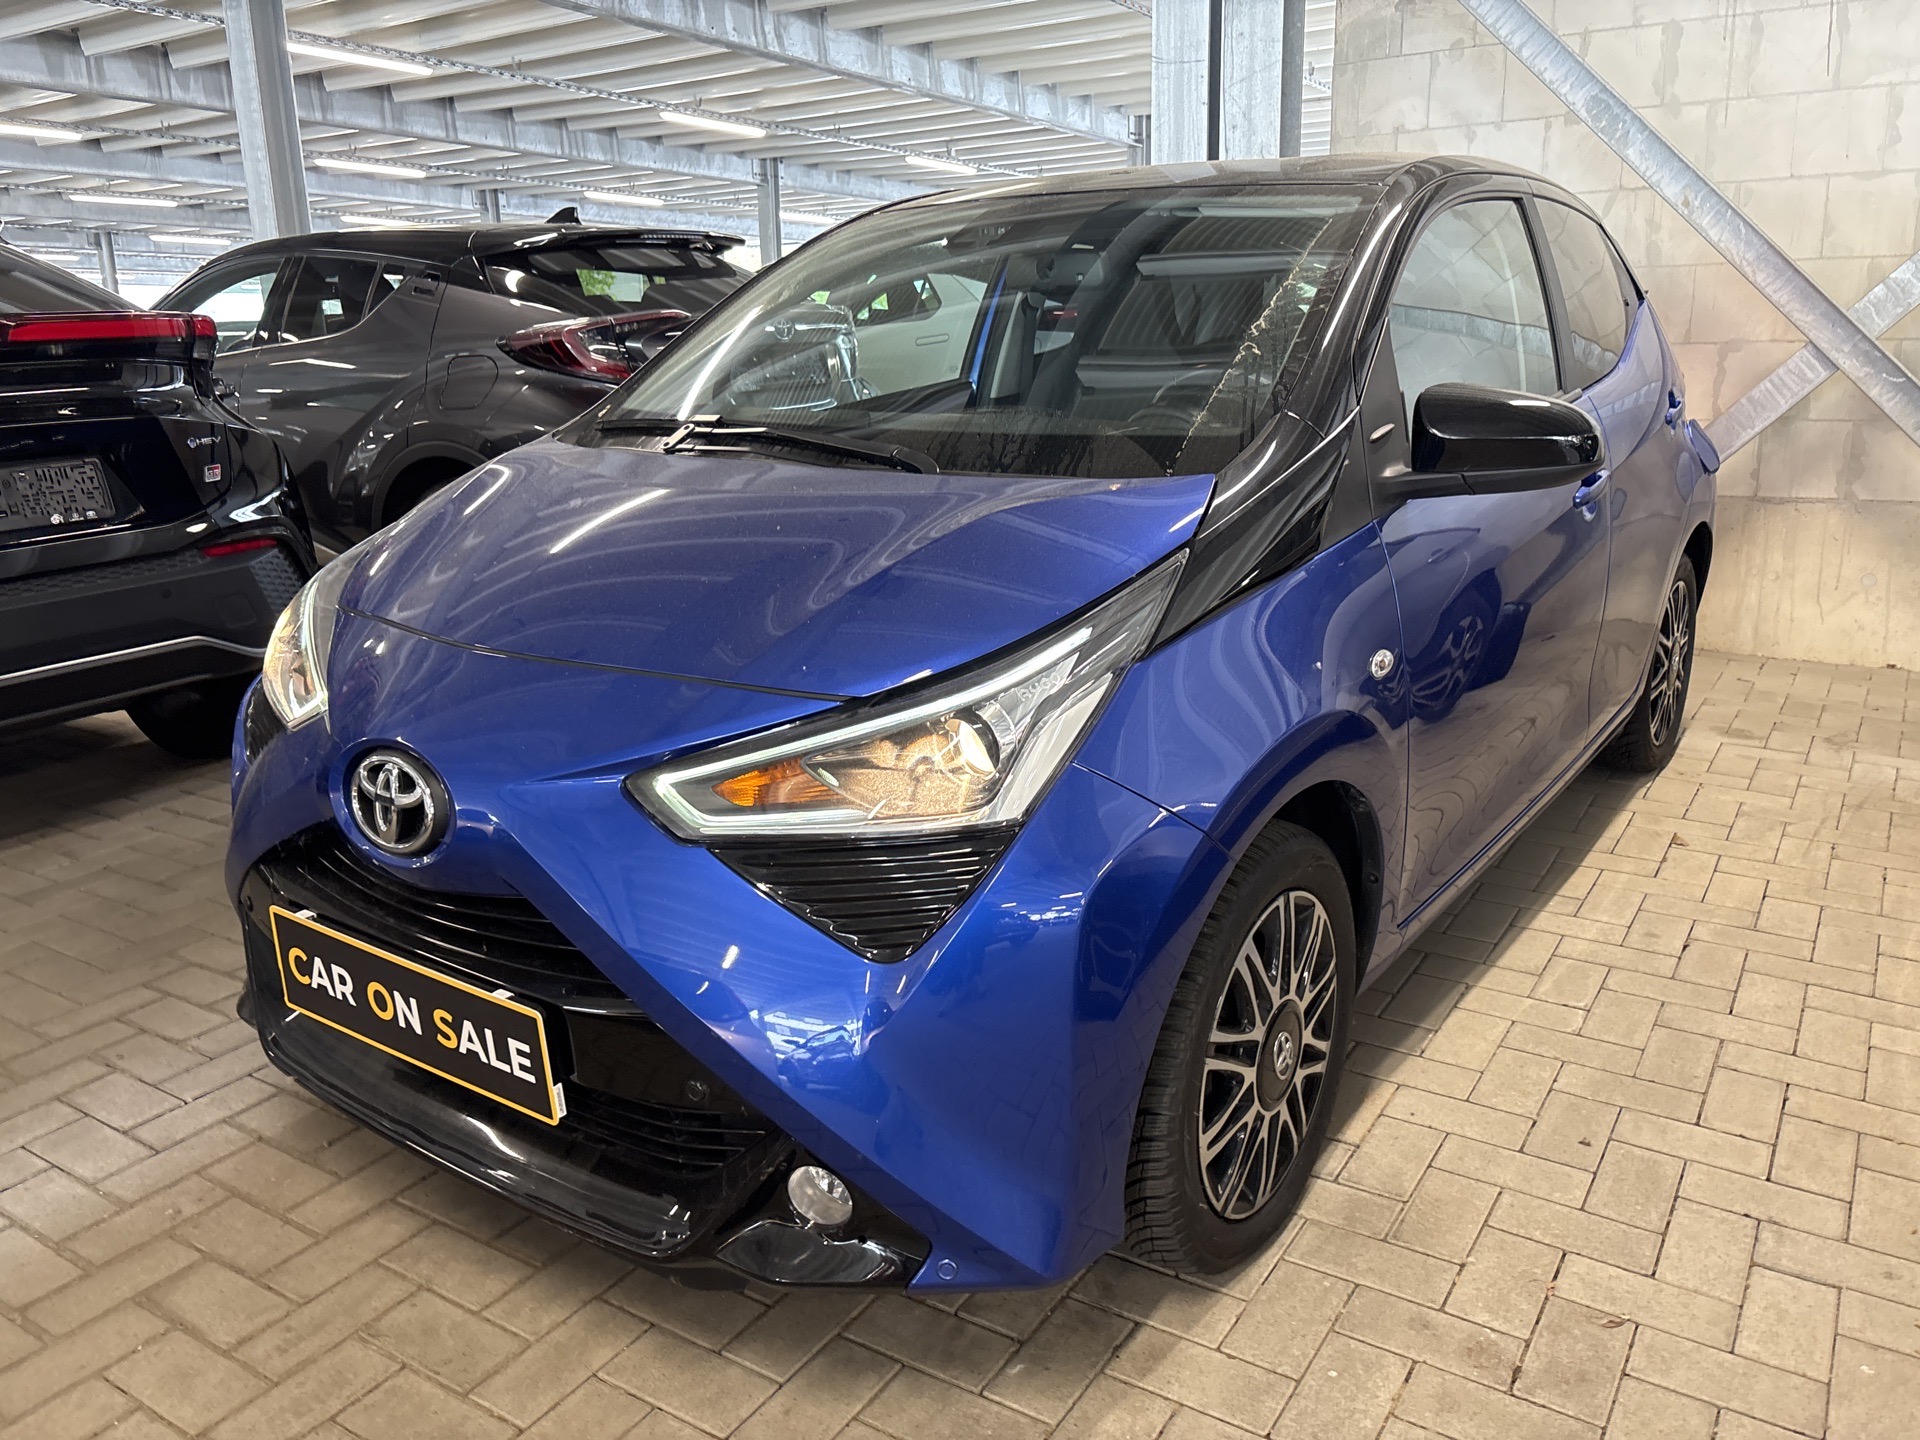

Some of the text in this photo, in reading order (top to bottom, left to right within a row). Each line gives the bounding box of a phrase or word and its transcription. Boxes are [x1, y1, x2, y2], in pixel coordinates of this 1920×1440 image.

[288, 947, 536, 1084] CAR ON SALE
